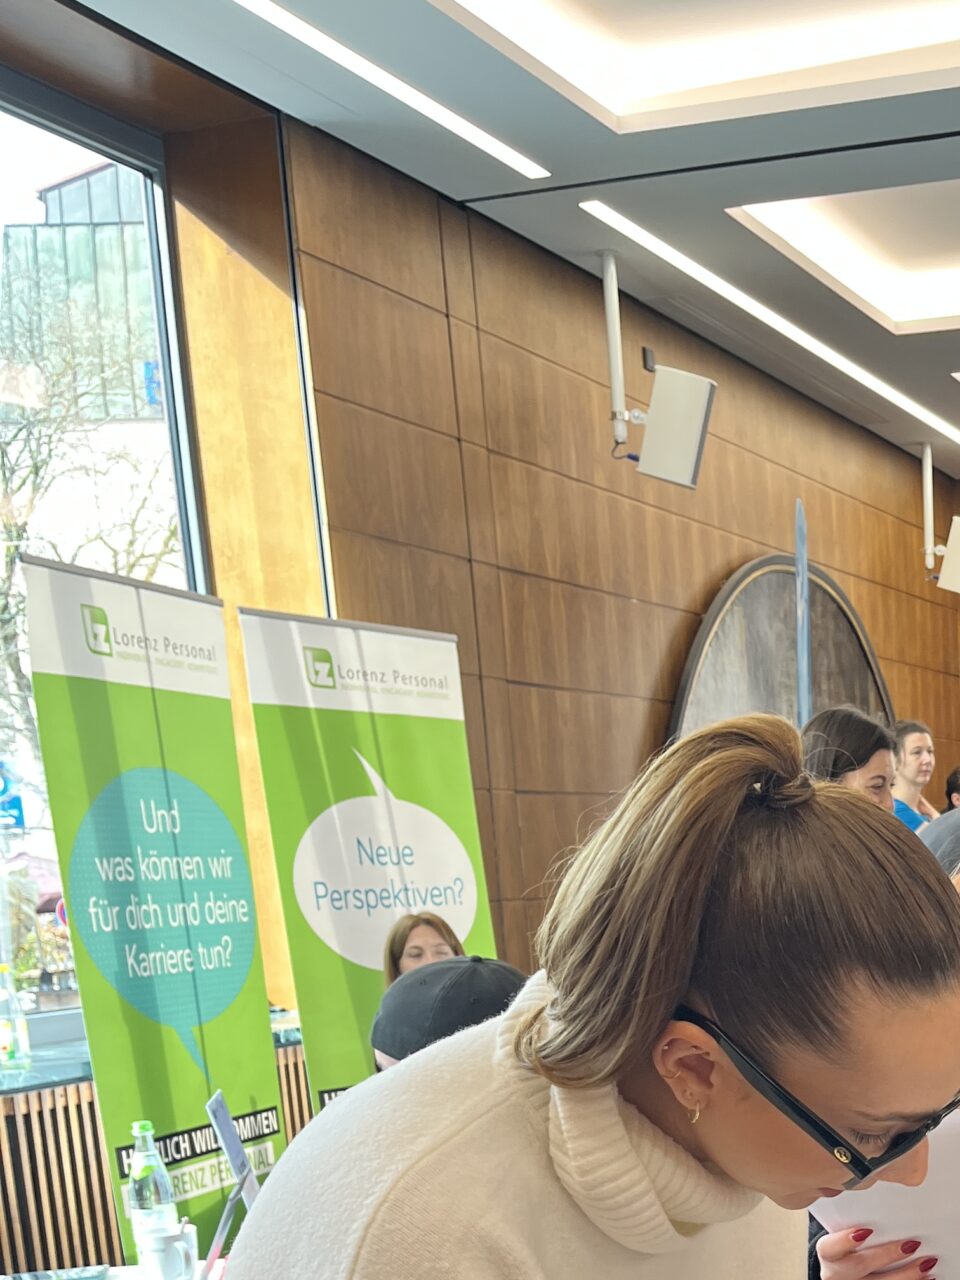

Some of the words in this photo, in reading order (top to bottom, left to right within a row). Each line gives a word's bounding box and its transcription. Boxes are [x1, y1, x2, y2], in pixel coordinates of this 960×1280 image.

[112, 626, 159, 651] Lorenz
[163, 636, 217, 661] Personal
[337, 664, 387, 684] Lorenz
[393, 669, 449, 690] Personal
[140, 799, 180, 834] Und
[95, 855, 135, 882] was
[137, 846, 205, 881] können
[208, 849, 232, 879] wir
[356, 837, 415, 867] Neue
[88, 896, 120, 933] für
[125, 893, 163, 930] dich
[167, 892, 200, 927] und
[204, 891, 249, 925] deine
[313, 877, 465, 916] Perspektiven?
[125, 942, 194, 978] Karriere
[198, 935, 232, 970] tun?
